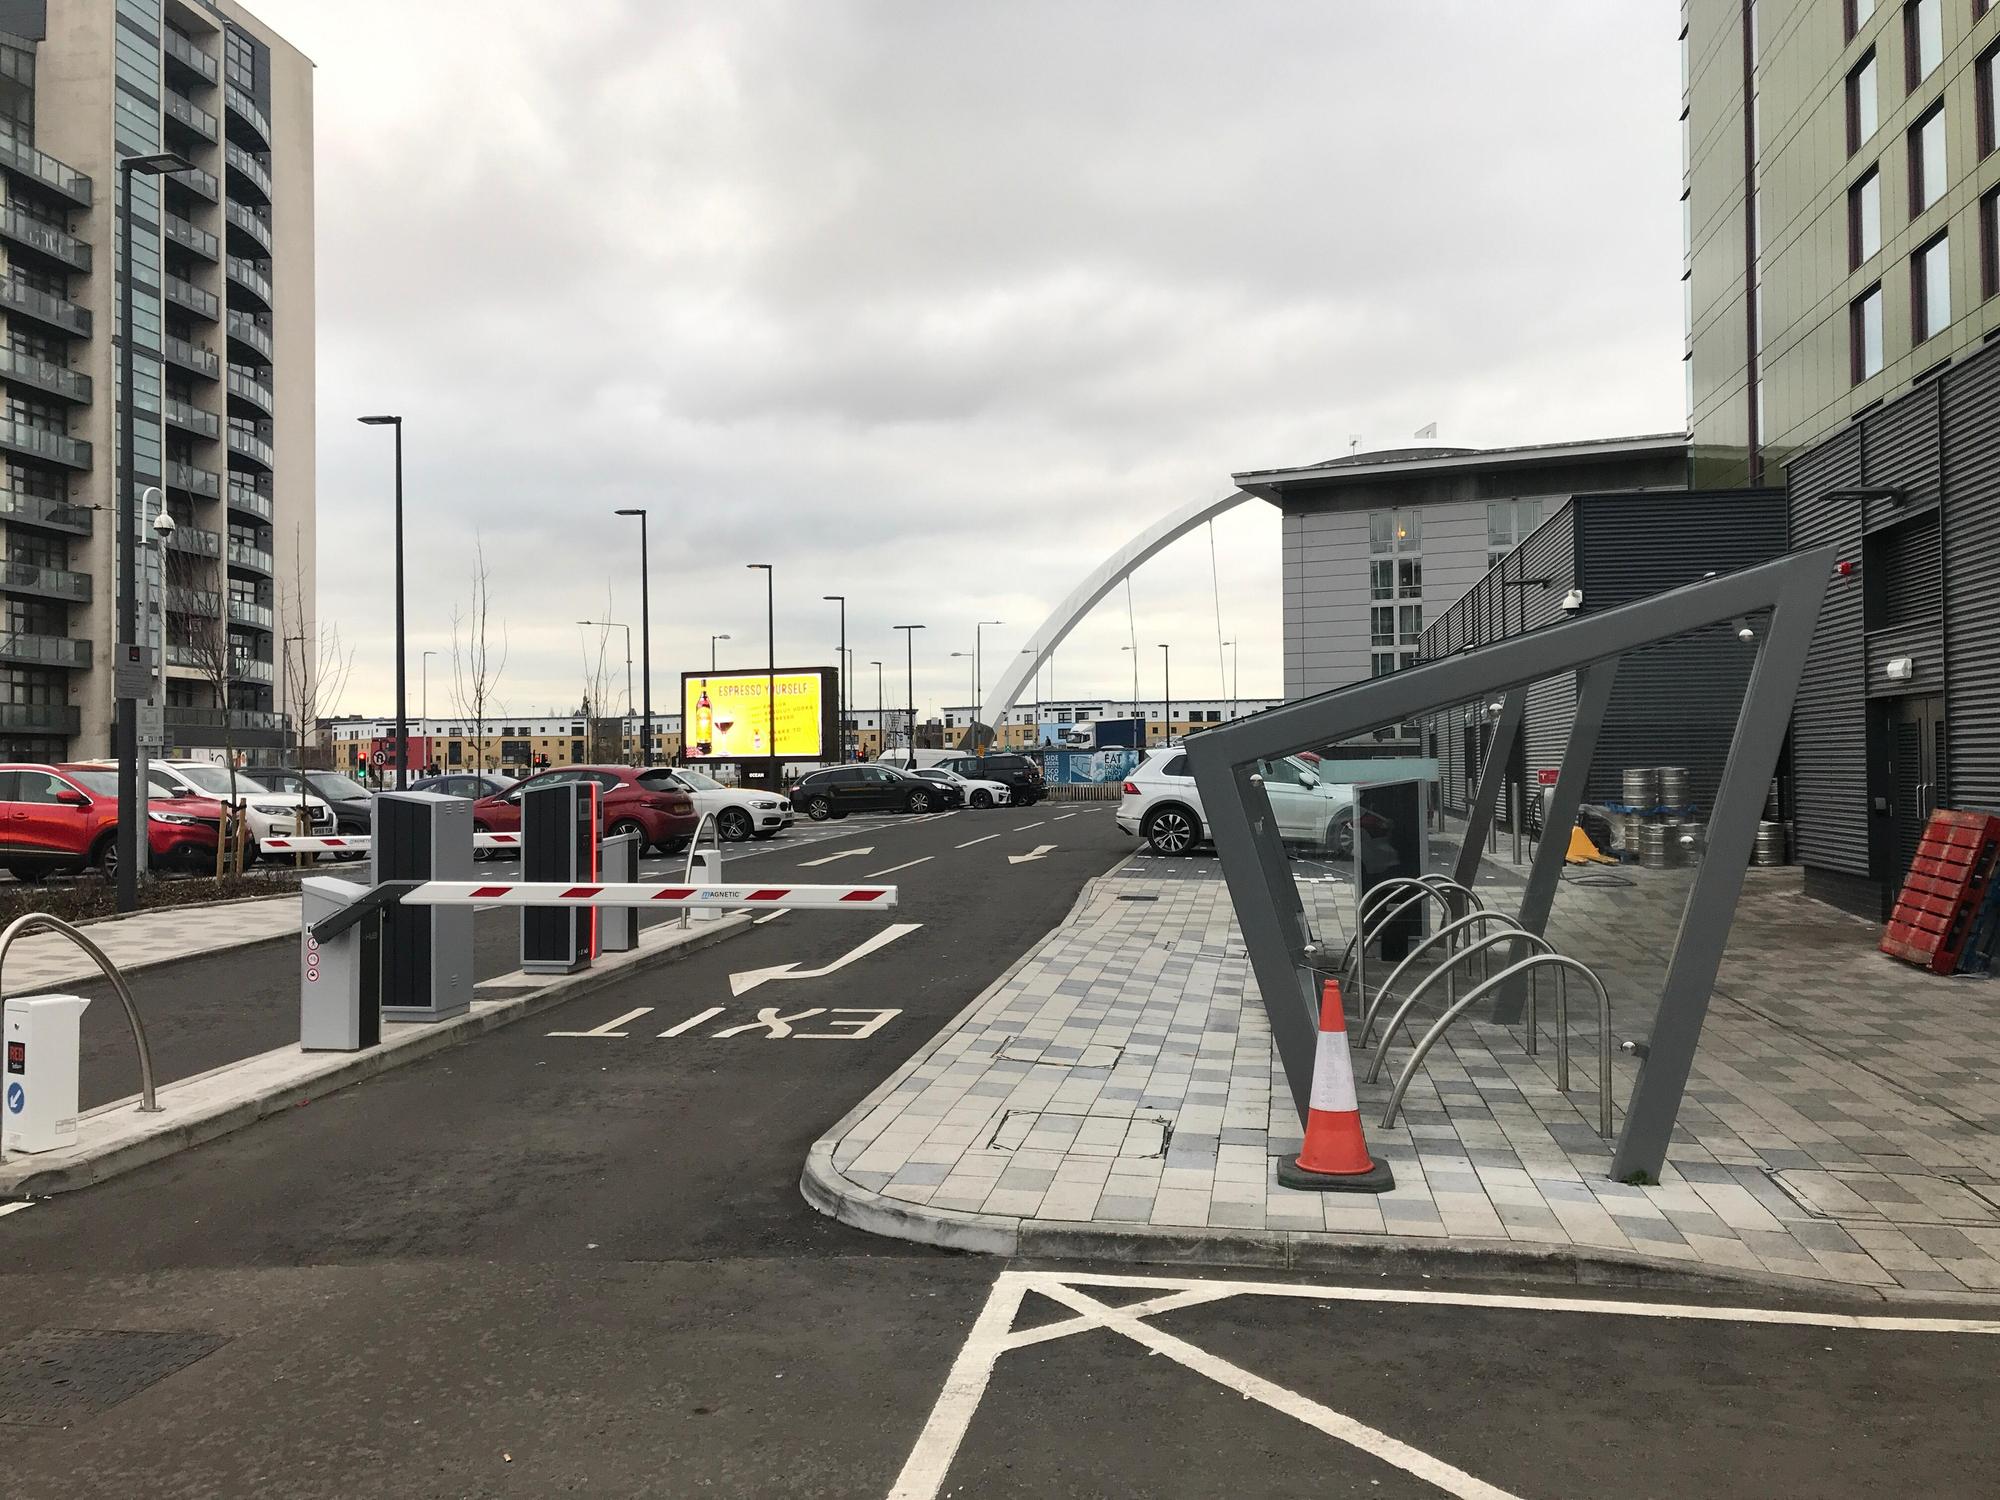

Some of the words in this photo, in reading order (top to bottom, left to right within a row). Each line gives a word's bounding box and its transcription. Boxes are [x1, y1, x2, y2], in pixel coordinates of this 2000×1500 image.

[719, 684, 762, 696] ESPRESSO
[764, 683, 808, 695] YURSELF
[1104, 753, 1122, 764] EAT
[543, 1007, 904, 1039] EXIT
